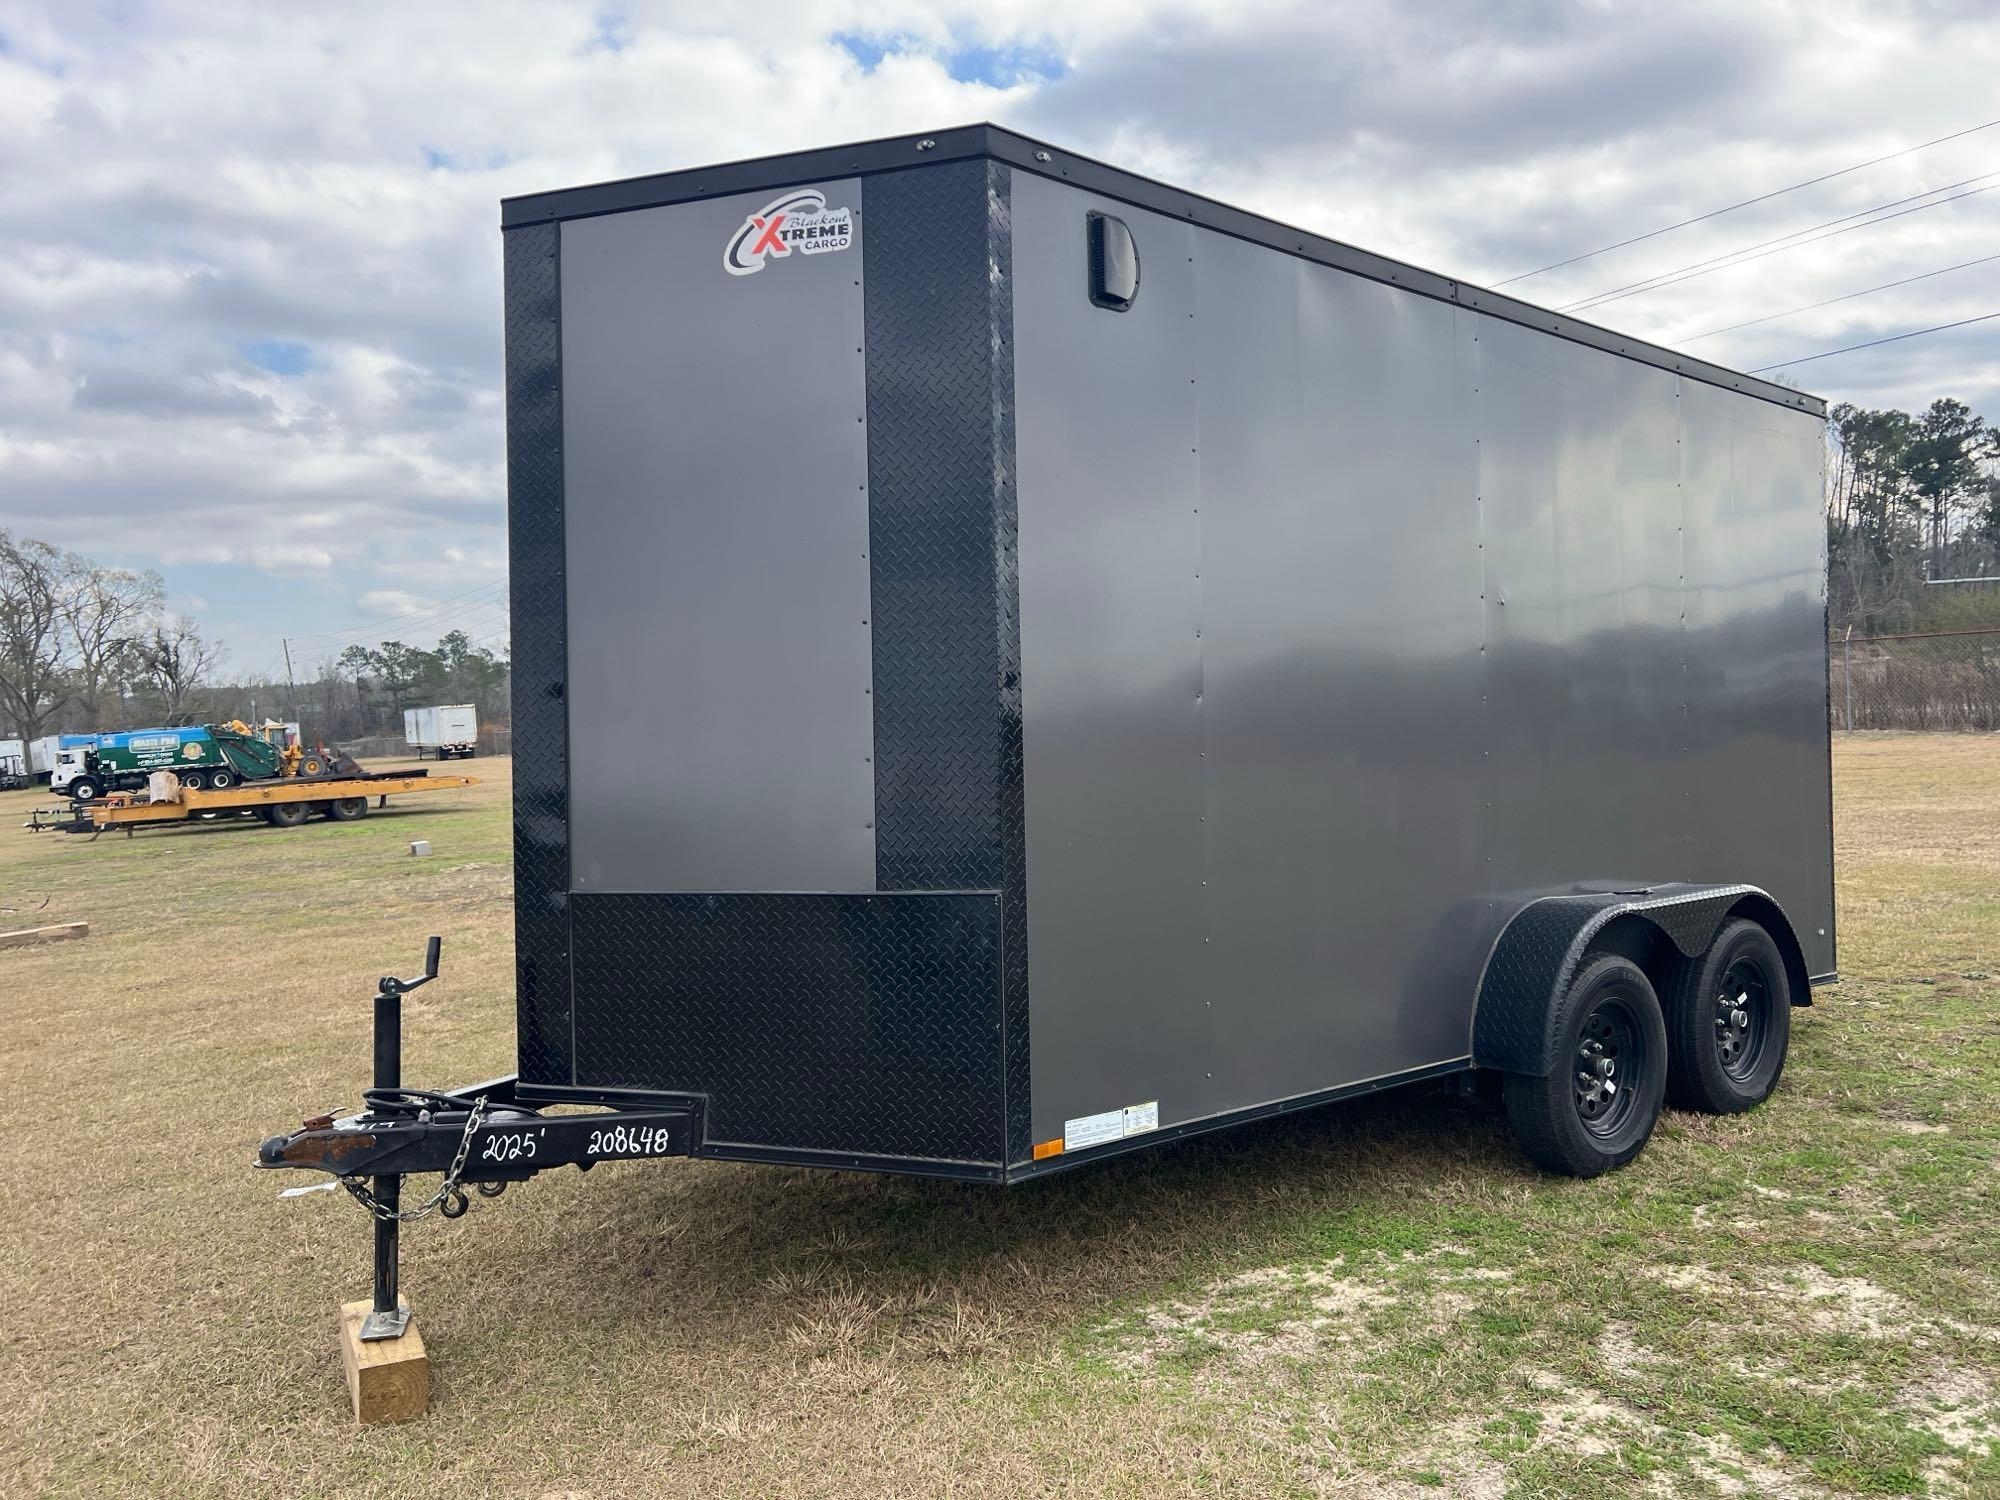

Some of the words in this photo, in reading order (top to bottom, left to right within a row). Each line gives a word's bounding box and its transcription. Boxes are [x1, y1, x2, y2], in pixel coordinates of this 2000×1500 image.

[790, 215, 847, 228] Blackout
[805, 237, 848, 250] CARGO
[587, 1125, 669, 1154] 208648
